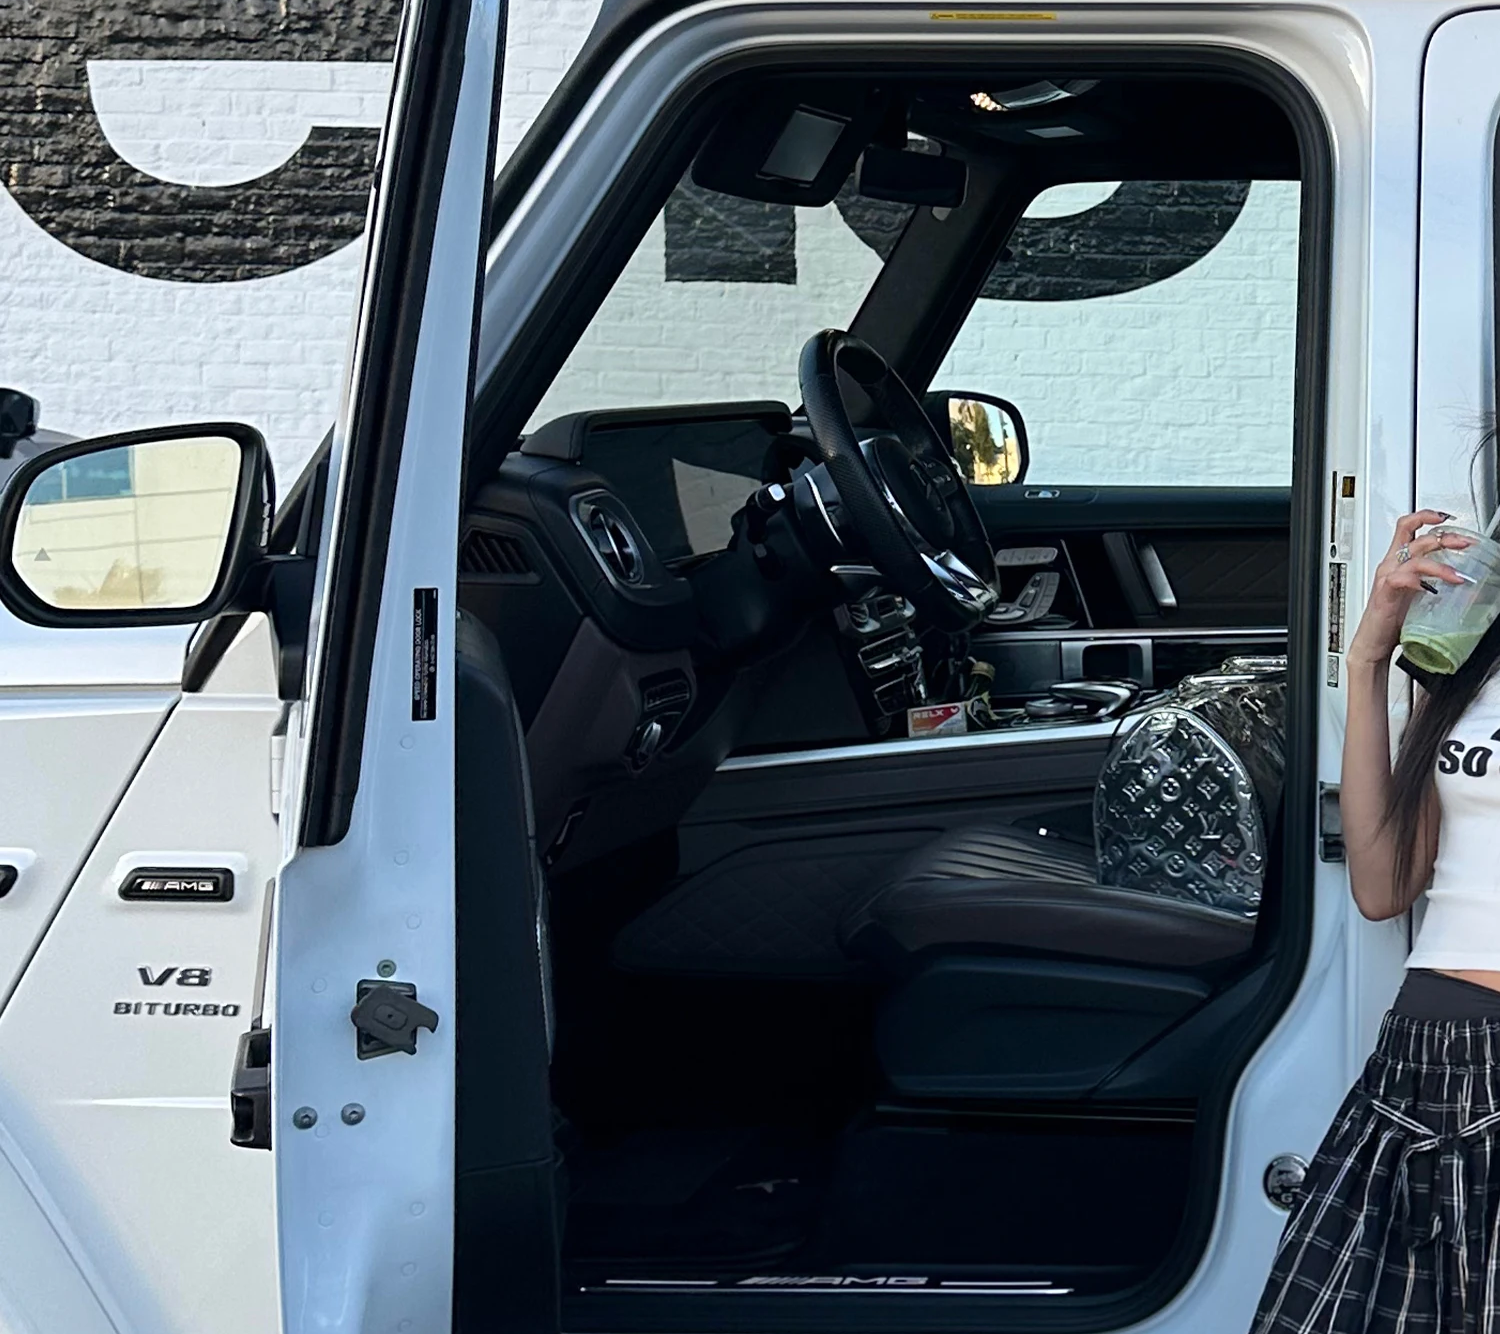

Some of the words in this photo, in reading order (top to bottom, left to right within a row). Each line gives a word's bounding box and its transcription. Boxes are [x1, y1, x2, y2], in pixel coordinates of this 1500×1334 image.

[914, 709, 944, 719] RELX
[1438, 740, 1493, 778] so
[163, 880, 214, 892] AMG
[137, 966, 214, 987] V8
[113, 1000, 240, 1018] BITURBO
[800, 1275, 929, 1286] AMG
